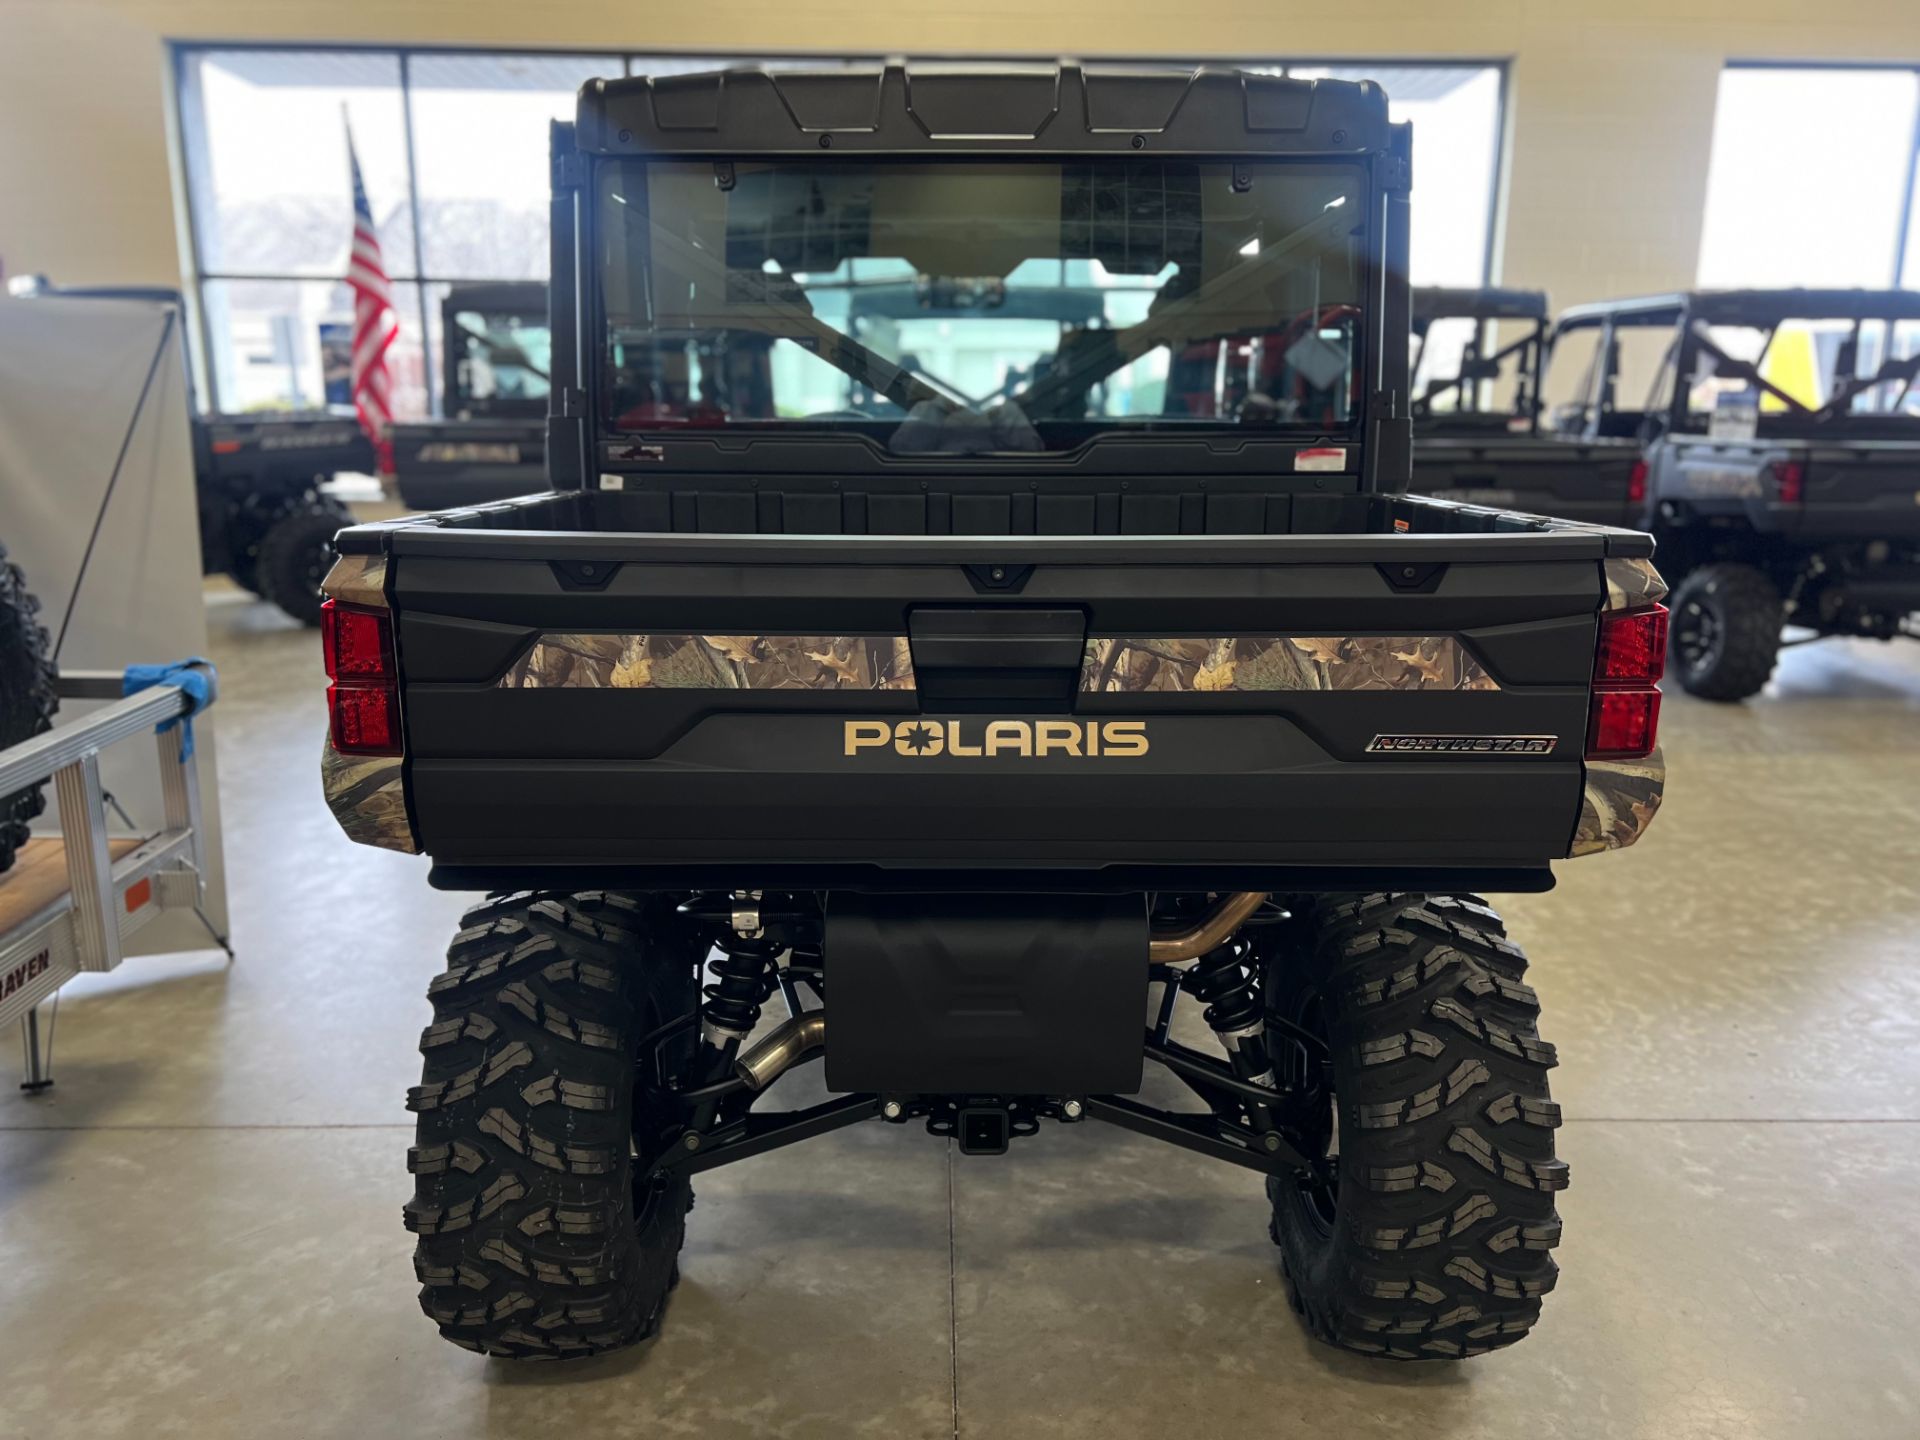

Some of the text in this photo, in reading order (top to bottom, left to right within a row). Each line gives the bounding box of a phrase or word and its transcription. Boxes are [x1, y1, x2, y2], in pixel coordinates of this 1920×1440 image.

[844, 720, 1149, 756] POLARIS
[1376, 738, 1548, 751] NORTHSTAR
[0, 948, 49, 1002] AVEN
